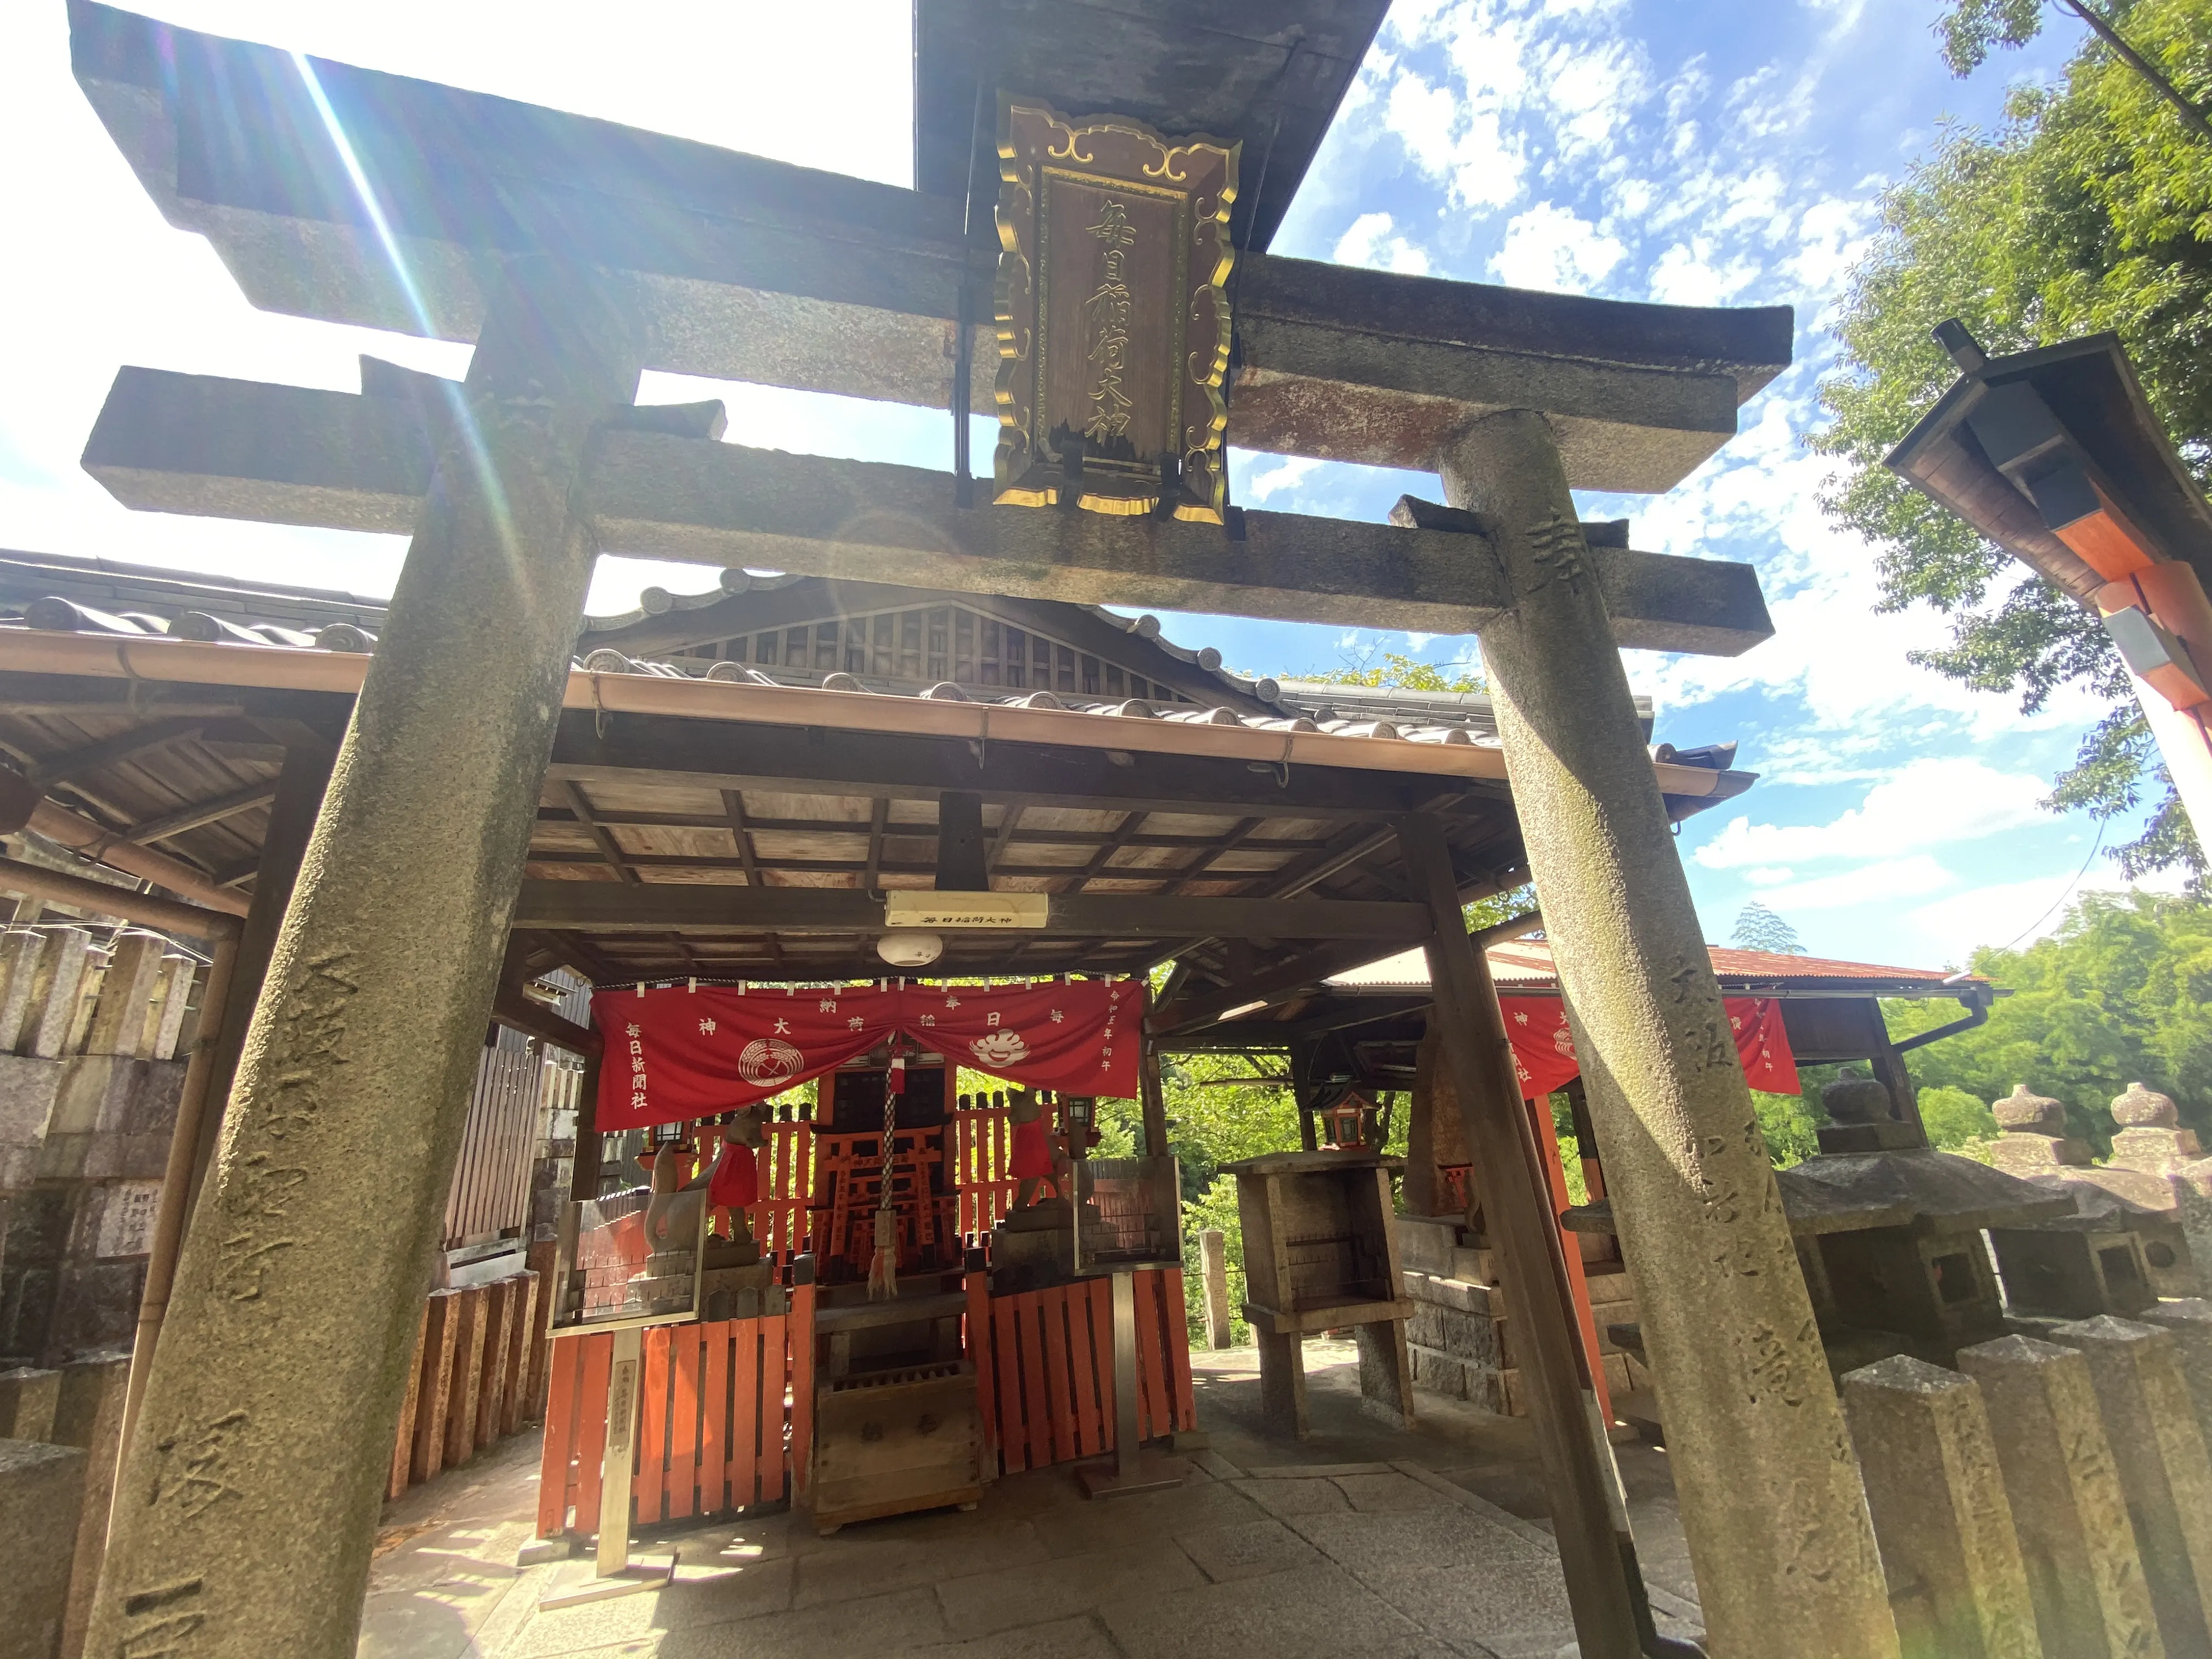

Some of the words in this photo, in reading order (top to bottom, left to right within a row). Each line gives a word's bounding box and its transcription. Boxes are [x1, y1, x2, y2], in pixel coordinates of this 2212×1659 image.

[625, 1022, 647, 1110] 毎日新聞社
